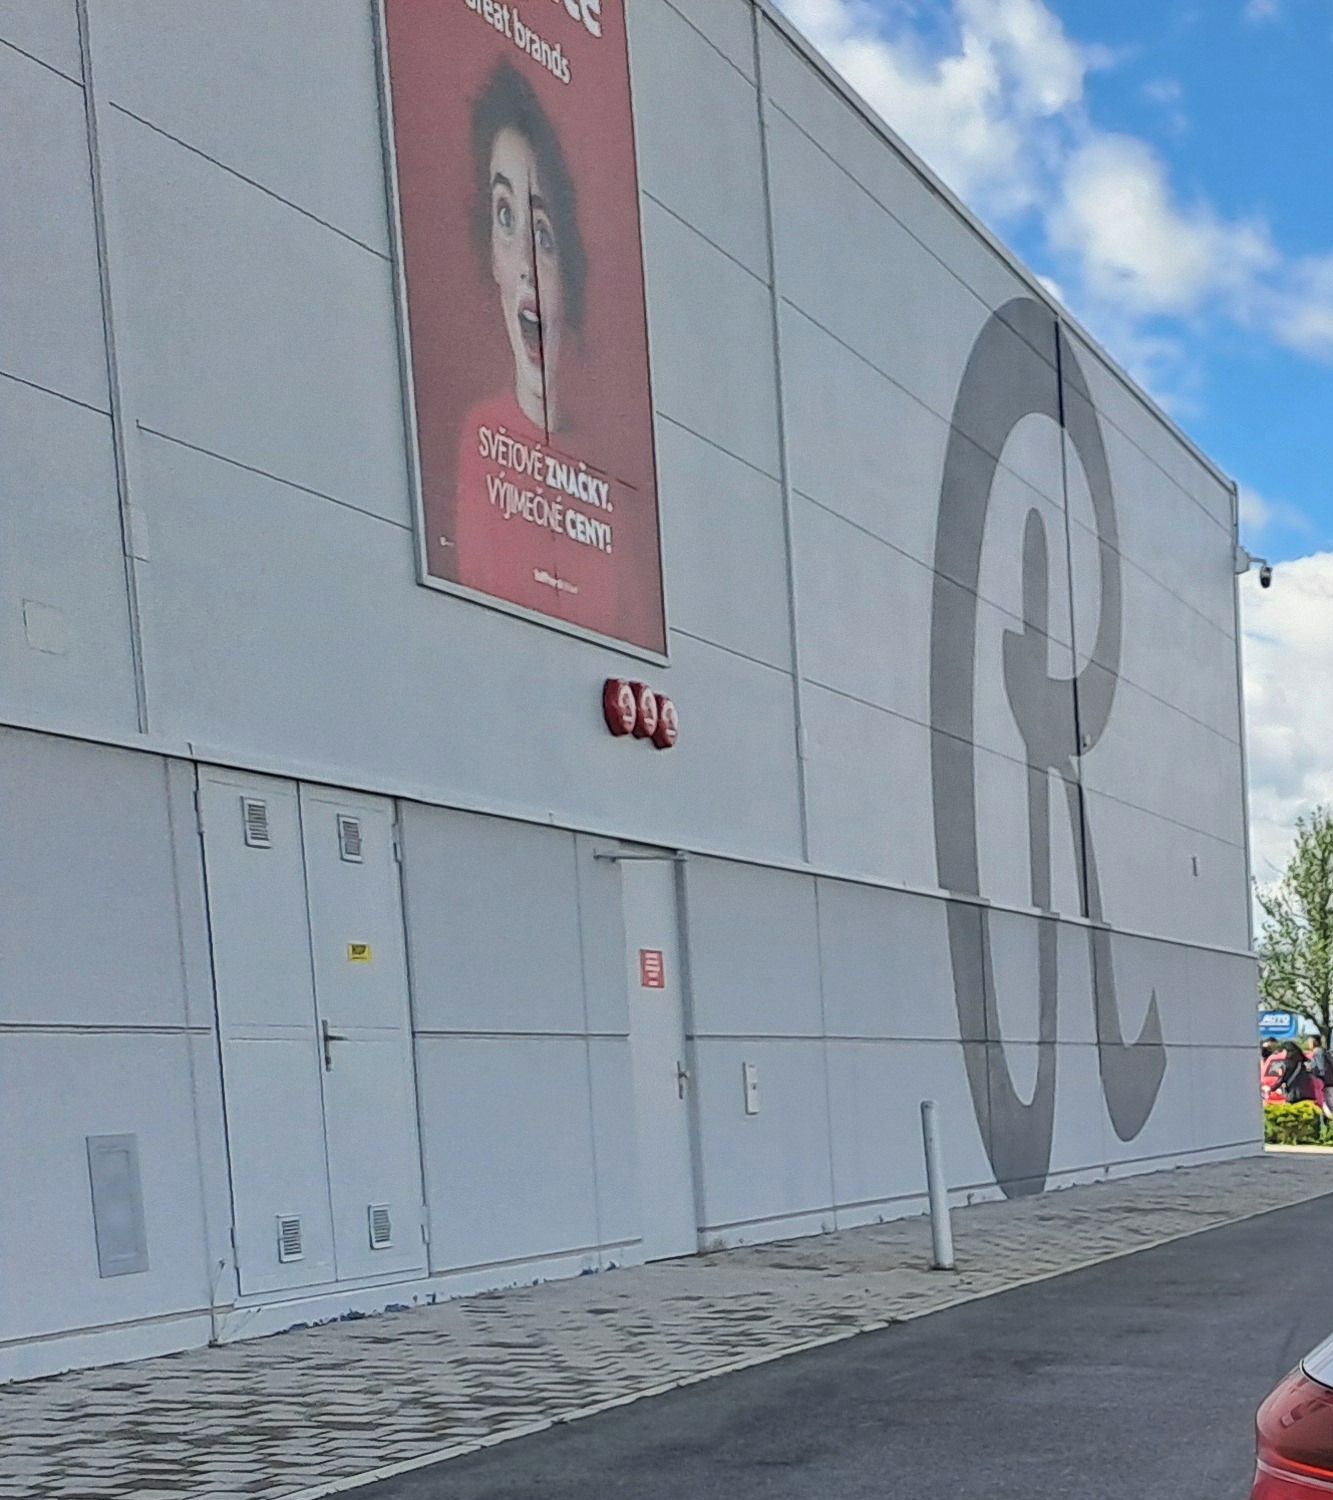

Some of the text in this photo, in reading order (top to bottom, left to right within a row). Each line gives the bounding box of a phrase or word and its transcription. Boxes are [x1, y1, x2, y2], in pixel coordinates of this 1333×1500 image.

[513, 8, 571, 84] brands
[479, 425, 614, 513] SVĚTOVÉ ZNAČKY.
[486, 471, 613, 554] VÝJIMEČNÉ CENY!
